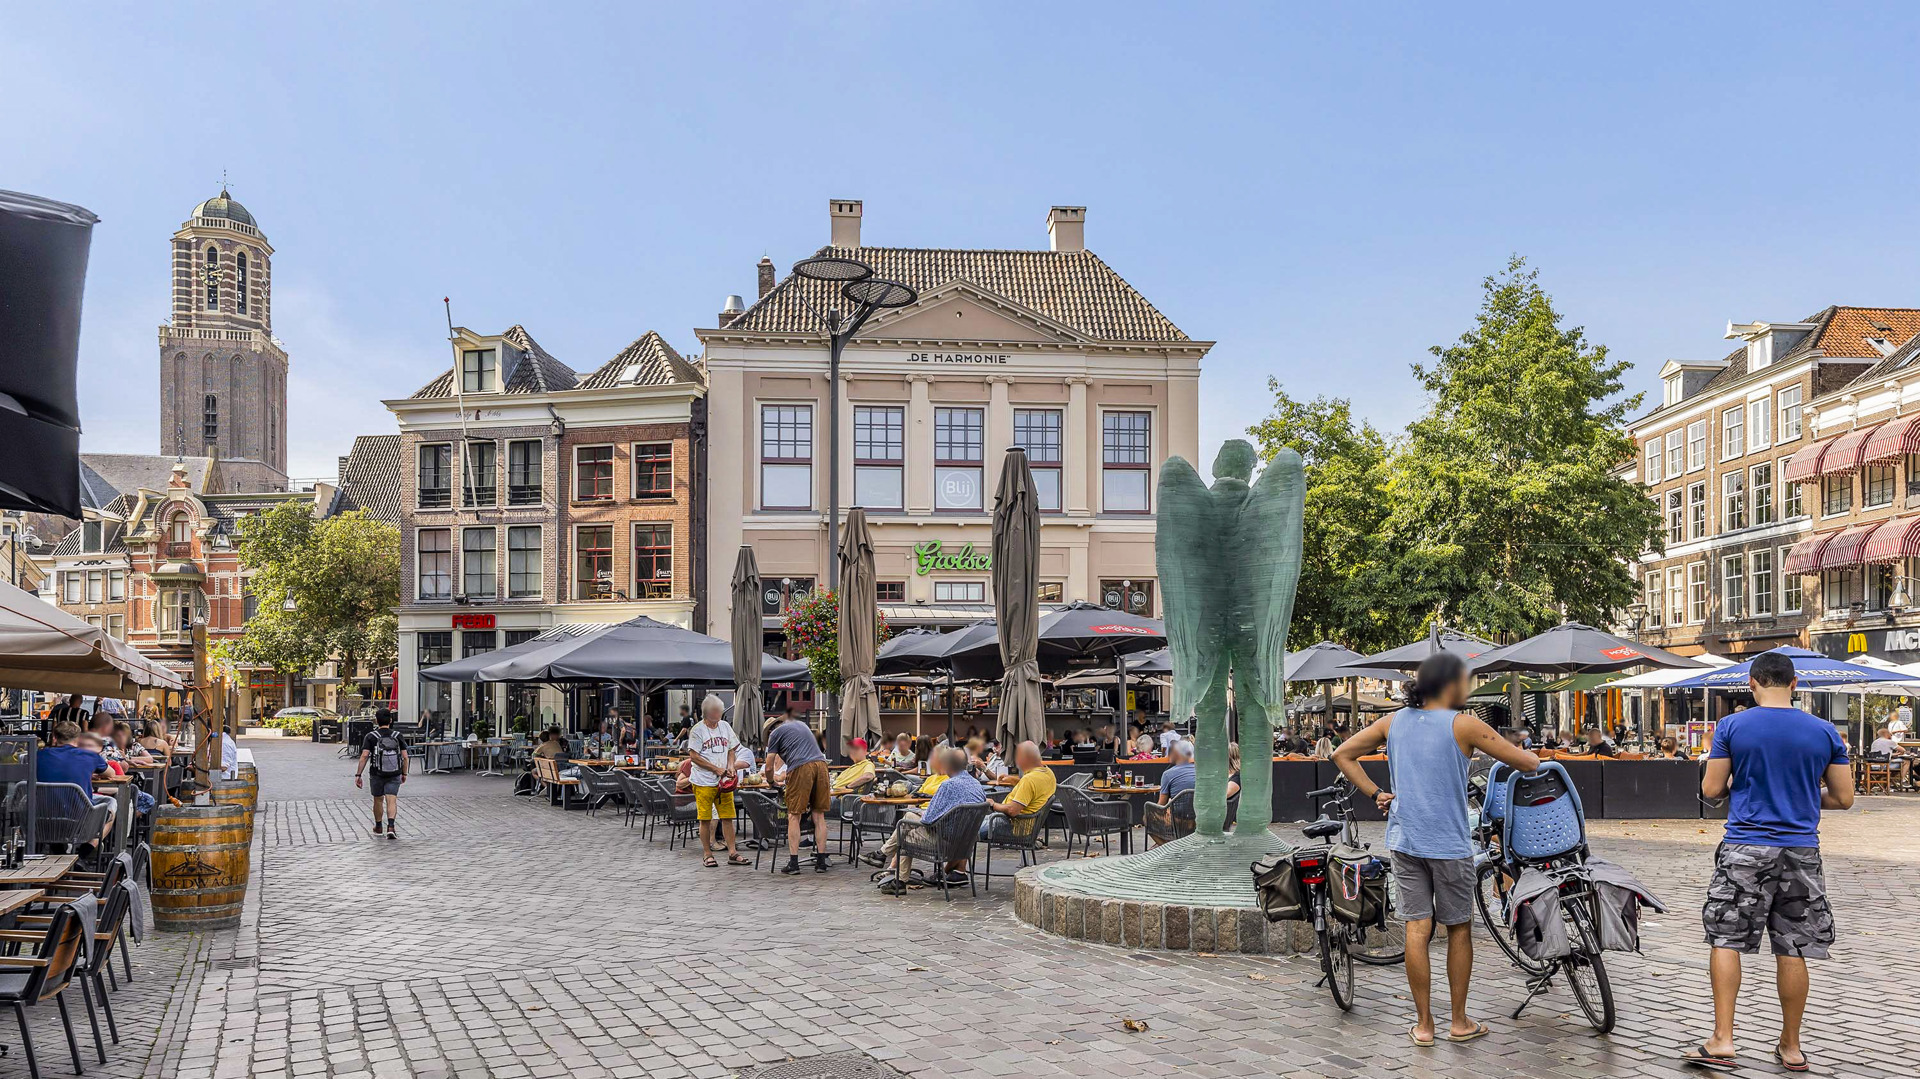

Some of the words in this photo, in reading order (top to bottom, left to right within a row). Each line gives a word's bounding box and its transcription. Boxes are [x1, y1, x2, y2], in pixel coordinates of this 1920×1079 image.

[946, 480, 970, 497] Blij
[452, 614, 496, 628] FEBO
[1884, 629, 1920, 651] Mc
[1795, 669, 1869, 677] PERONI
